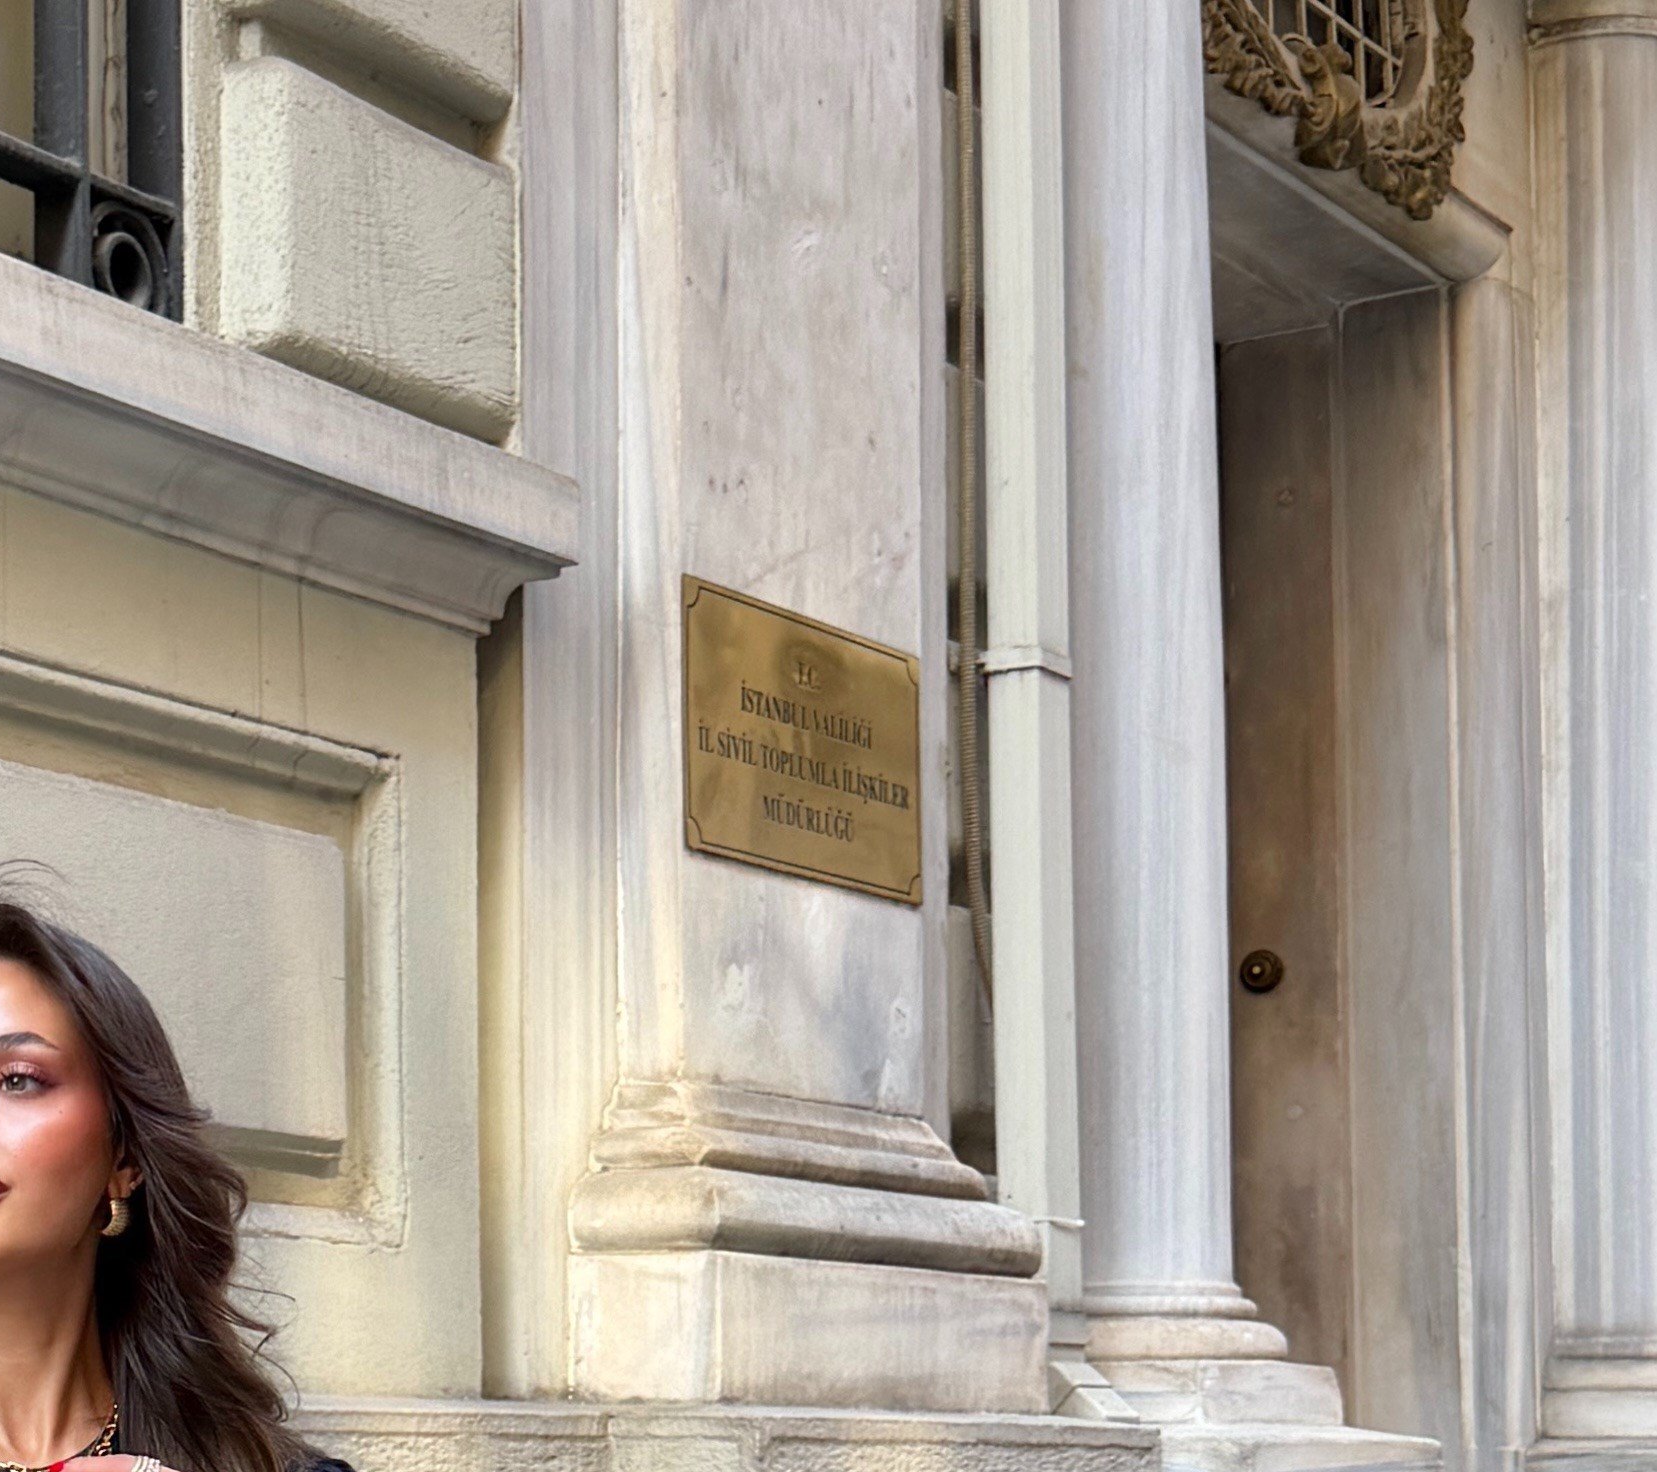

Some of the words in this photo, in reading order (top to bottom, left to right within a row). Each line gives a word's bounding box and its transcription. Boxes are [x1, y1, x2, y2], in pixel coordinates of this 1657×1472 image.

[741, 680, 809, 730] İSTANBUL
[813, 709, 872, 750] VALİLİĞİ
[698, 719, 714, 754] İL
[717, 727, 757, 766] SİVİL
[760, 746, 839, 789] TOPLUMLA
[842, 762, 909, 810] İLİŞKİLER
[762, 793, 855, 843] MÜDÜRLÜĞÜ
